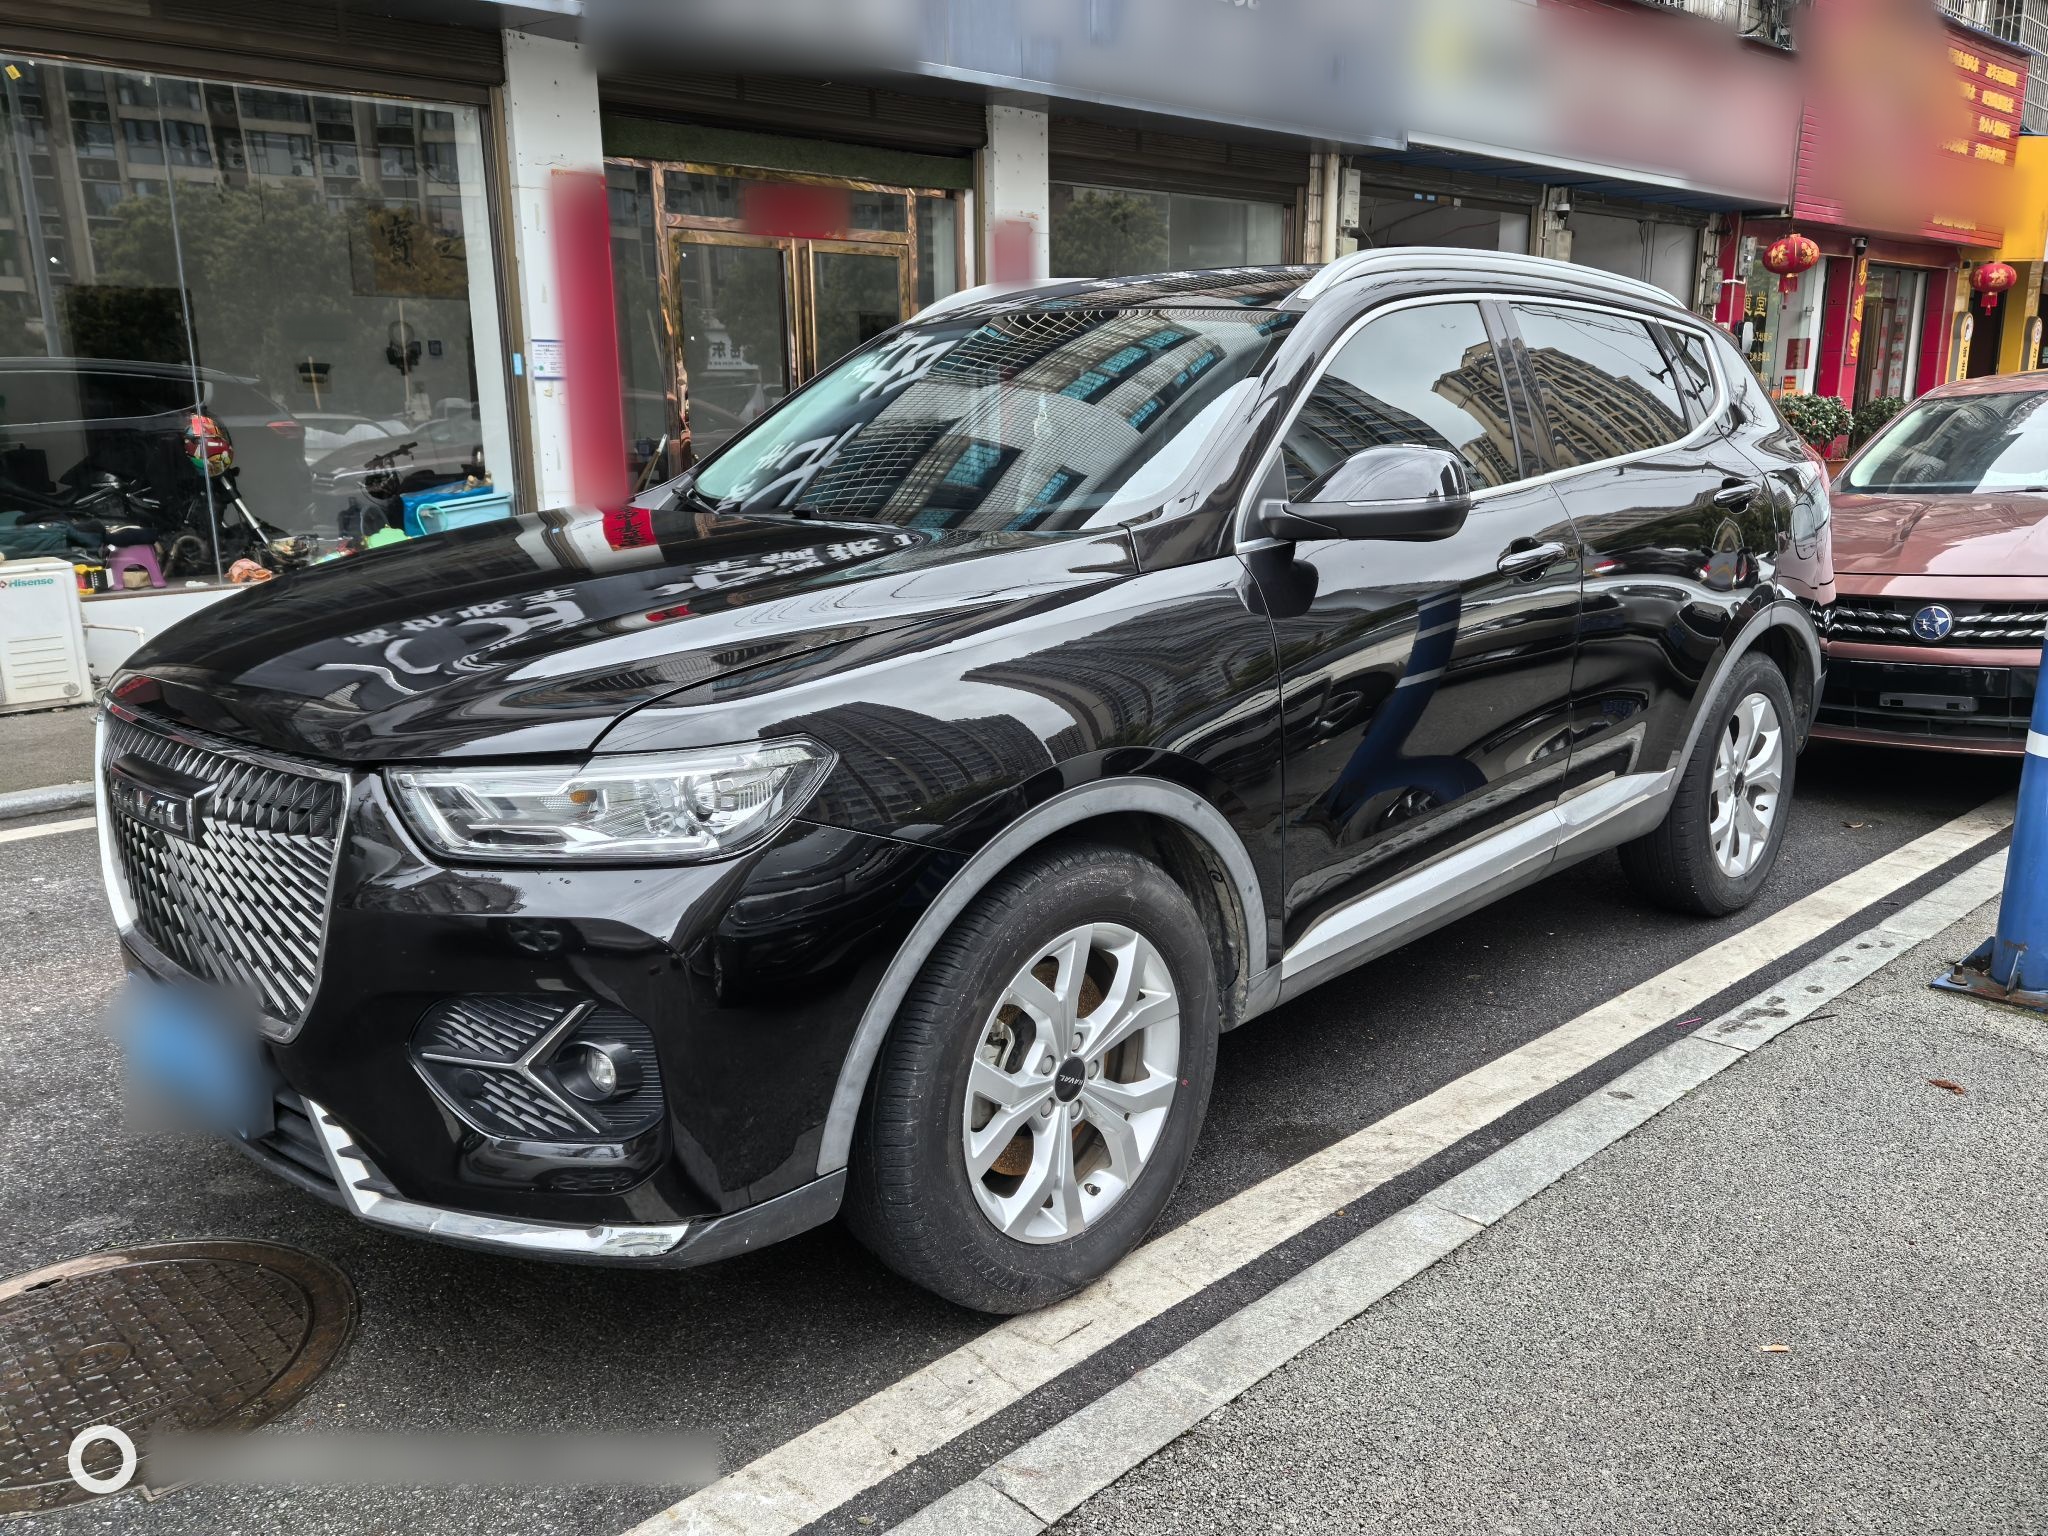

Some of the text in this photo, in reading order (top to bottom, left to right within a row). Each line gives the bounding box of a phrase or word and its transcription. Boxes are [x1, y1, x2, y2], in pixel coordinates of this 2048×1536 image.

[1849, 257, 1868, 358] 易道堂
[8, 577, 54, 588] Hisense
[1059, 1074, 1084, 1086] HAVAL
